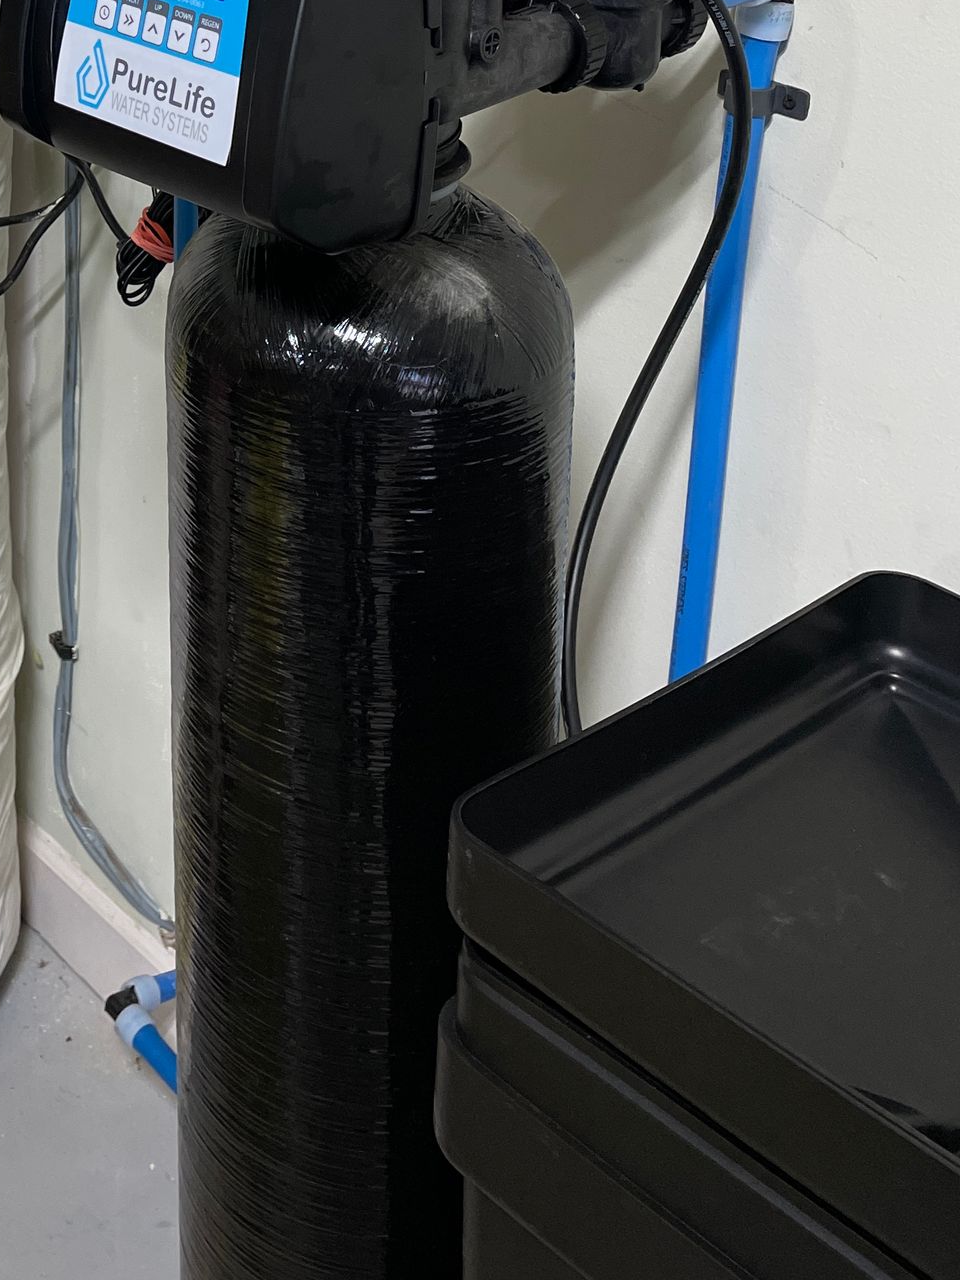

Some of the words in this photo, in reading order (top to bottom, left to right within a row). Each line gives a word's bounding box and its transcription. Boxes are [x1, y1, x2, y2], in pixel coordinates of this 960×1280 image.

[153, 3, 164, 13] UP
[174, 9, 194, 22] DOWN
[200, 16, 220, 30] REGEN
[111, 57, 217, 120] PureLife
[110, 90, 151, 125] WATER
[151, 104, 210, 145] SYSTEMS
